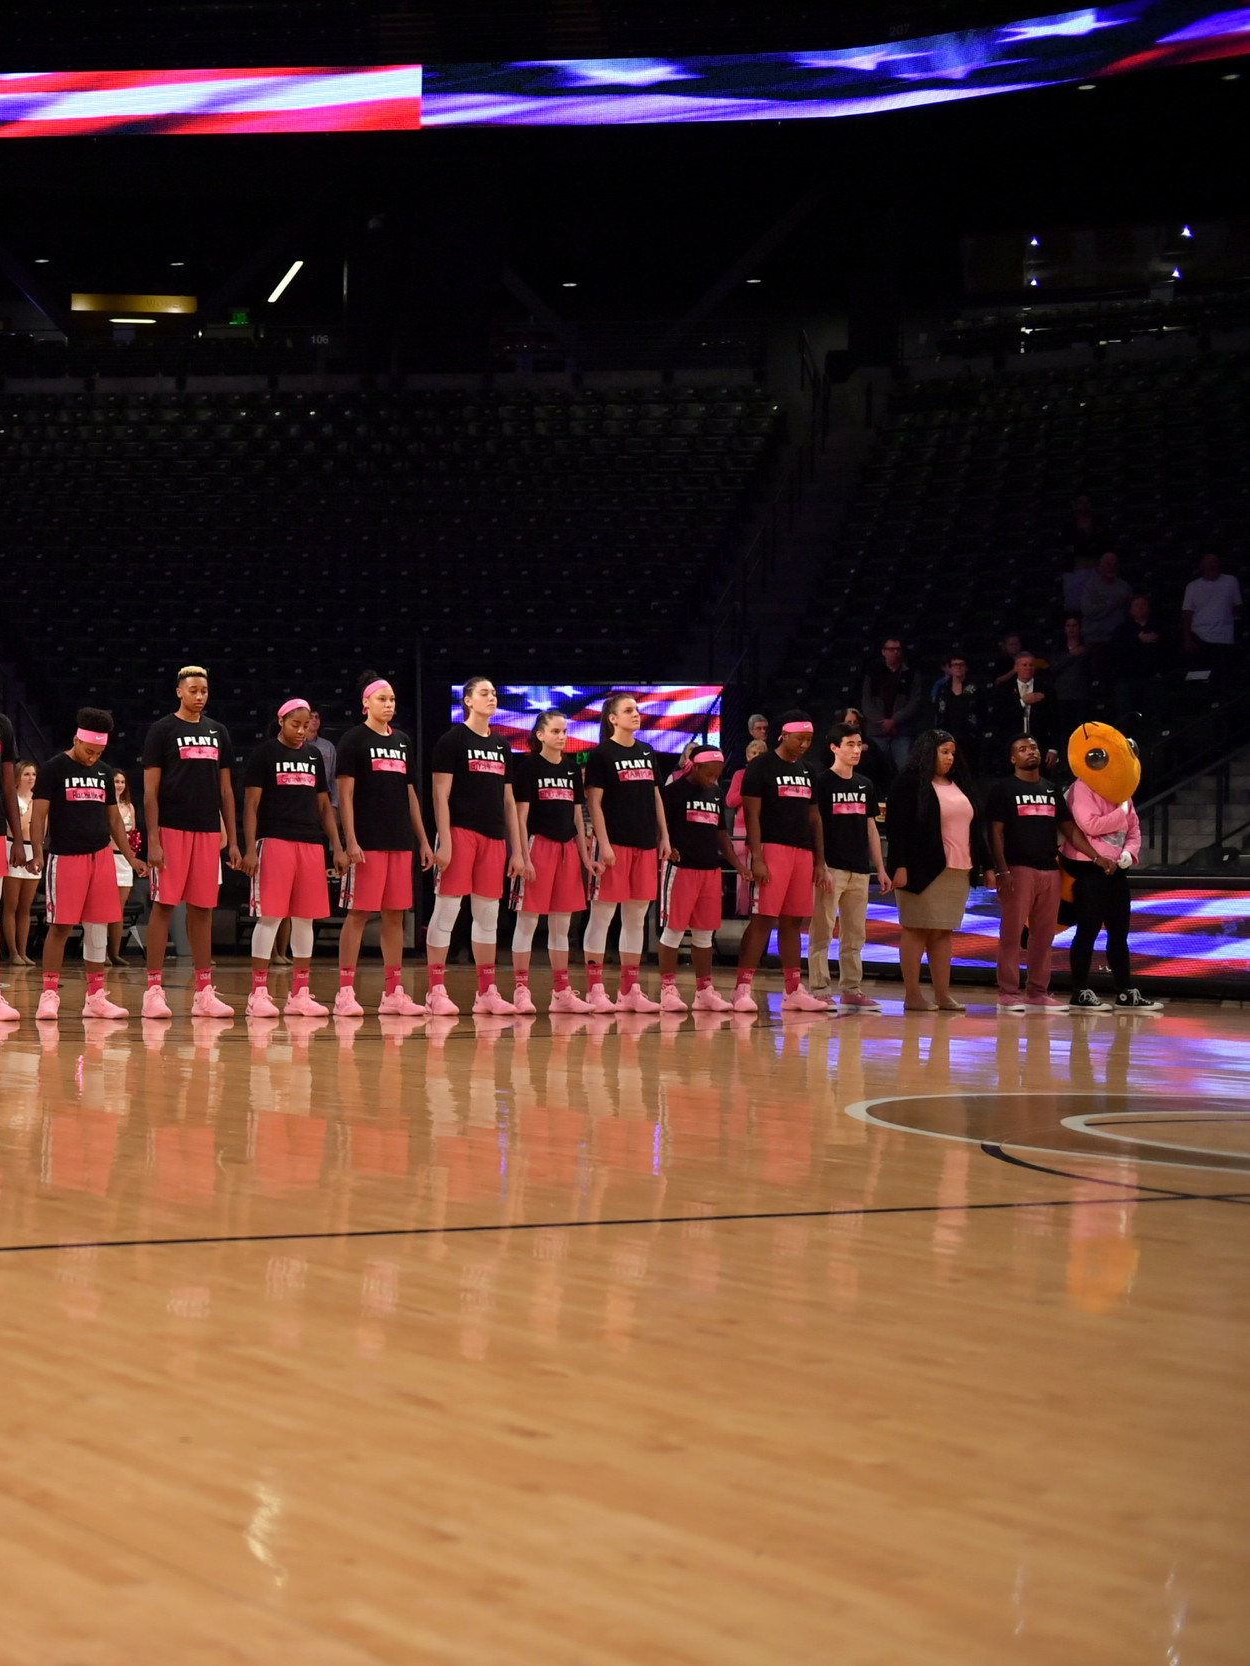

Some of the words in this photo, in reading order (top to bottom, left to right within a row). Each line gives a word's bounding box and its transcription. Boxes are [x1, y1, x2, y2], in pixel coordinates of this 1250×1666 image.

[176, 737, 183, 747] I
[183, 736, 212, 746] PLAY
[370, 747, 376, 758] I
[376, 747, 401, 760] PLAY
[467, 749, 473, 760] I
[473, 749, 499, 761] PLAY
[276, 762, 281, 773] I
[282, 761, 310, 773] PLAY
[614, 761, 621, 771] I
[620, 759, 646, 769] PLAY
[64, 778, 70, 788] I
[71, 777, 99, 788] PLAY
[100, 779, 107, 790] 4
[537, 778, 543, 788] I
[543, 777, 569, 788] PLAY
[775, 776, 782, 786] I
[782, 775, 806, 786] PLAY
[832, 792, 837, 803] I
[837, 792, 859, 803] PLAY
[860, 792, 867, 803] 4
[1015, 795, 1021, 805] I
[1021, 794, 1048, 805] PLAY
[1049, 796, 1056, 806] 4
[692, 800, 717, 813] PLAY
